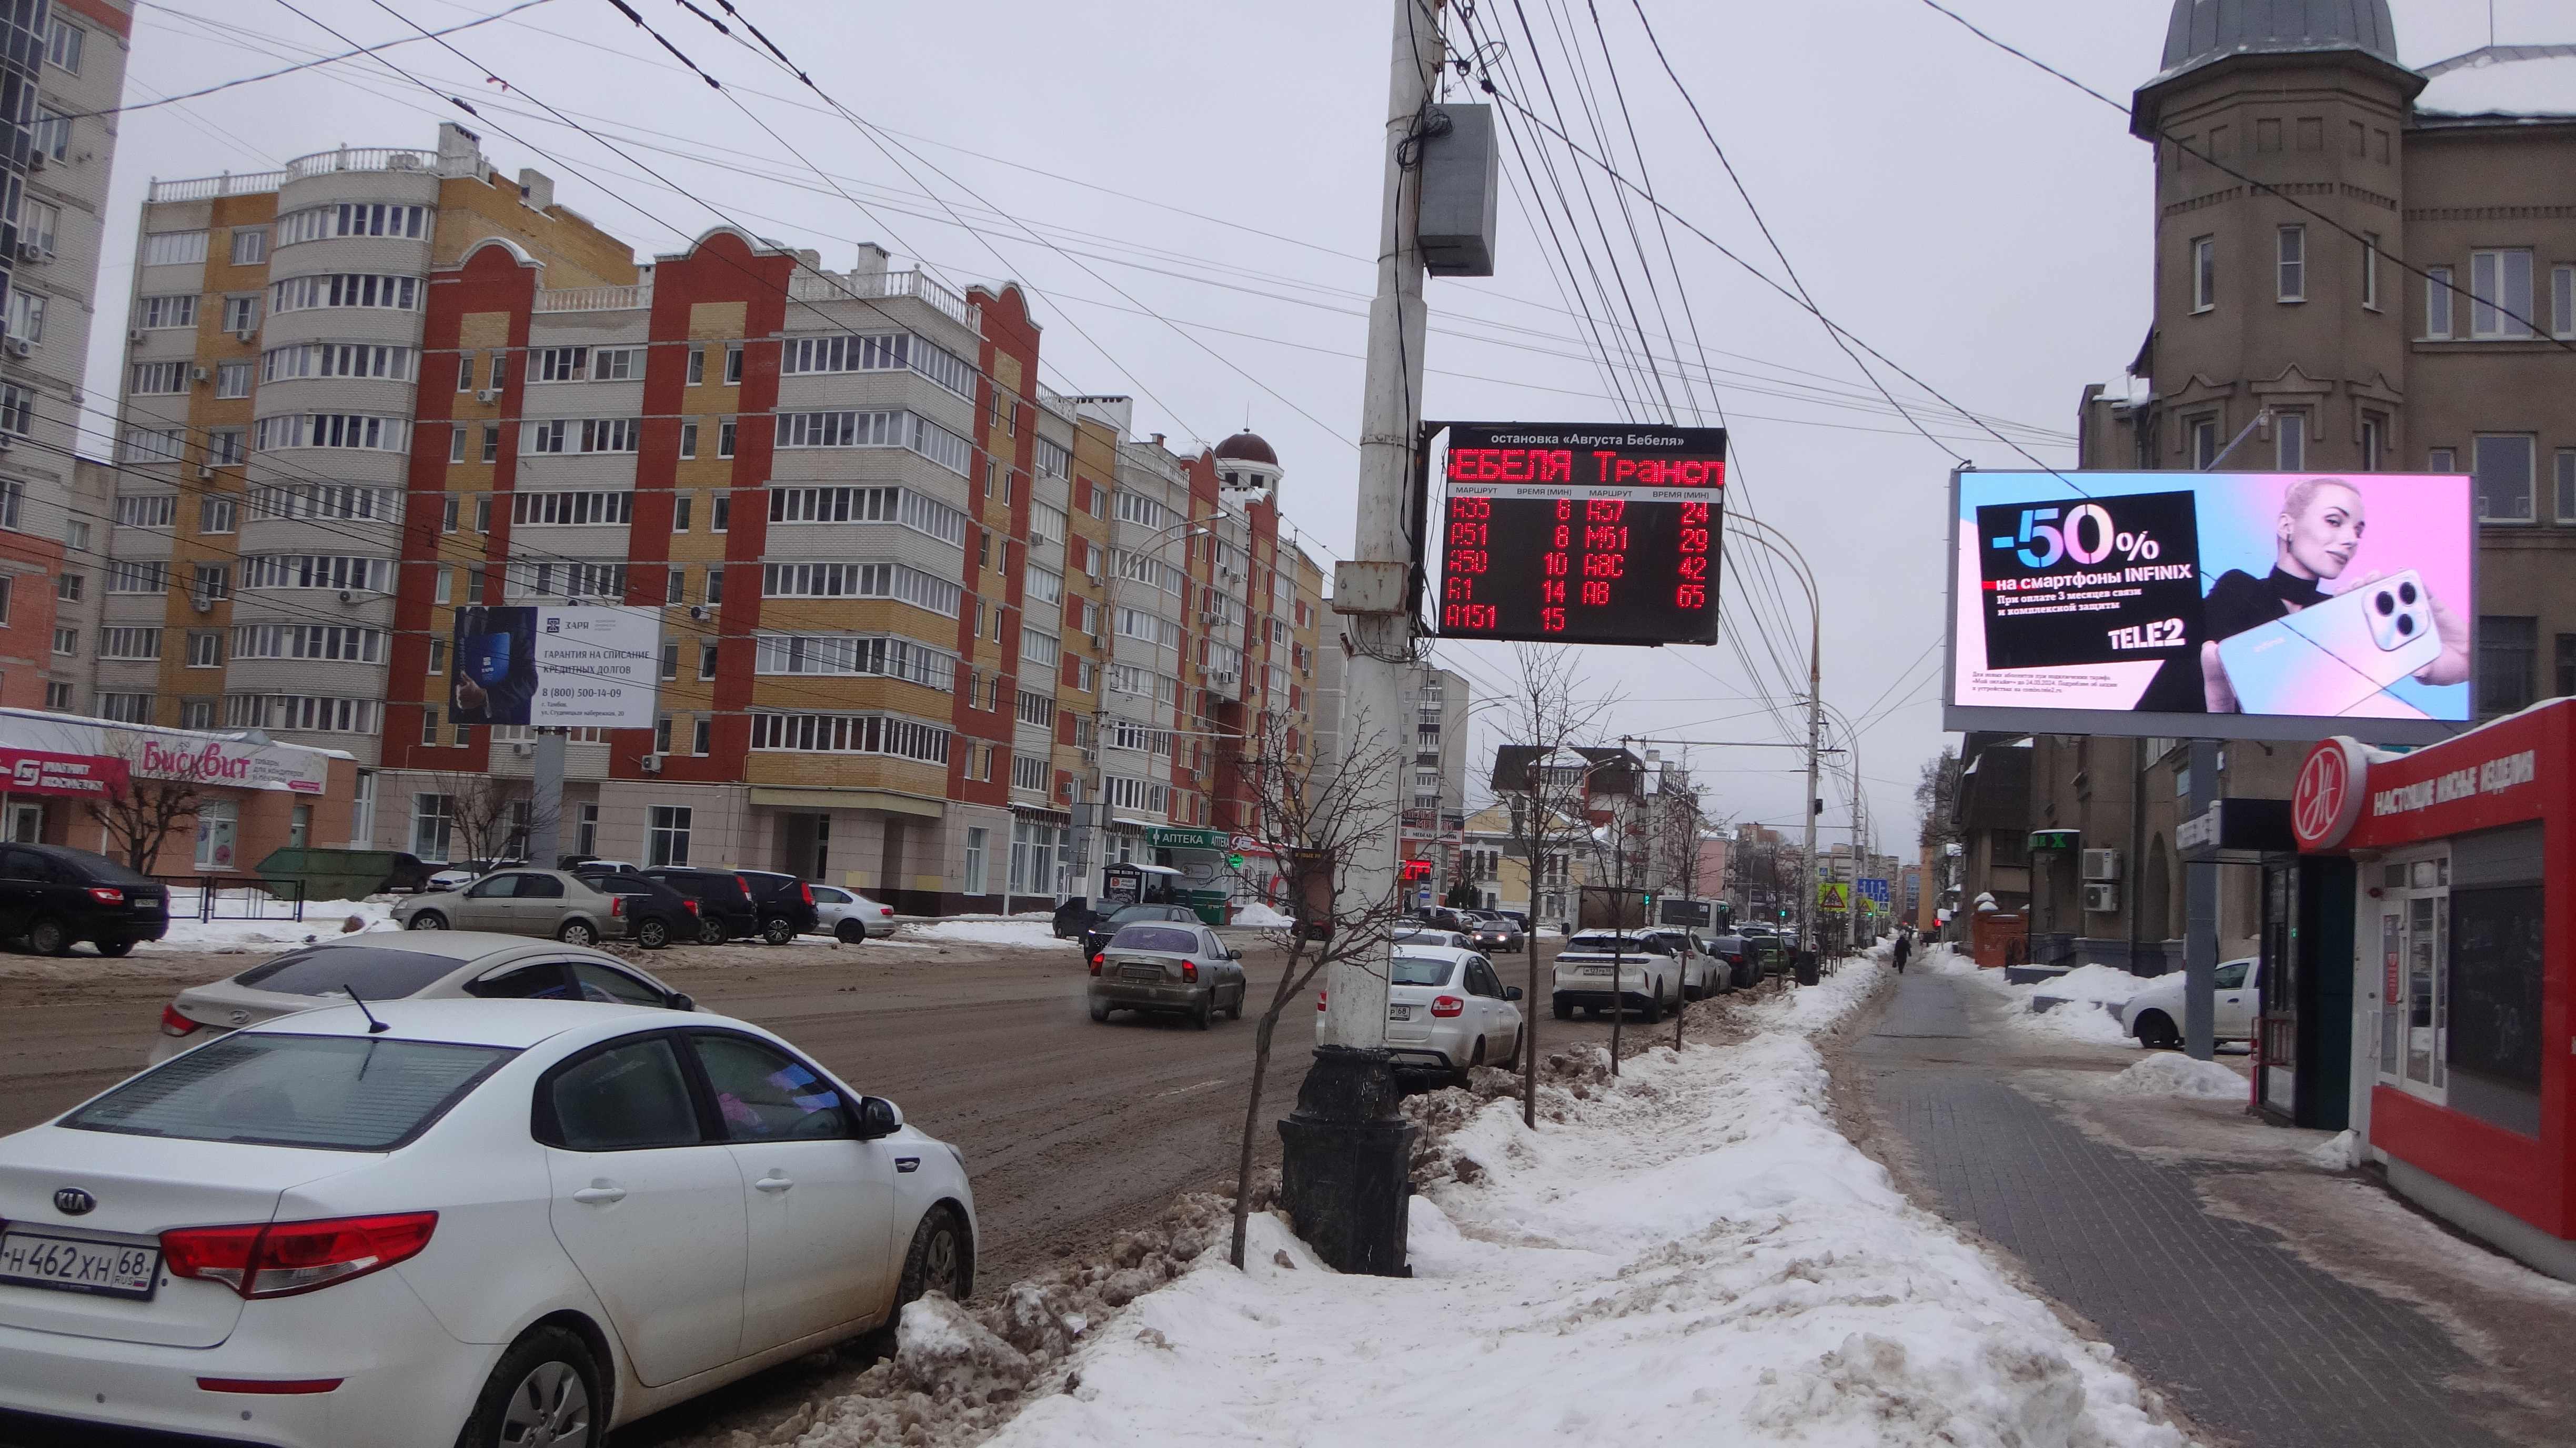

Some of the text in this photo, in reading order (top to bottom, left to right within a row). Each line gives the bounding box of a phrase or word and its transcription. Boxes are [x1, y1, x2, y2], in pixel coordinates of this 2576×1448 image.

[1491, 433, 1685, 446] остановка «Августа Бебеля»
[1557, 497, 1571, 520] 6
[1682, 500, 1709, 524] 24
[1556, 525, 1569, 548] 8
[1681, 528, 1708, 552] 29
[1544, 551, 1568, 576] 10
[1678, 556, 1707, 580] 42
[1996, 563, 2193, 591] на смартфоны INFINIX
[1542, 579, 1567, 604] 14
[1676, 584, 1706, 608] 65
[1996, 588, 2142, 606] При оплате 3 месяцев связи
[2007, 602, 2077, 616] комплексной
[2078, 601, 2120, 611] защиты
[565, 621, 589, 630] ЗАРЯ
[1542, 607, 1566, 631] 15
[2108, 618, 2186, 650] TELE2
[544, 650, 587, 659] ГАРАНТИЯ
[603, 650, 649, 659] СПИСАНИЕ
[543, 665, 631, 676] КРЕДИТНЫХ ДОЛГОВ
[542, 687, 622, 699] 8 (800) 500-14-09
[143, 741, 250, 780] Бисквит
[1415, 819, 1454, 831] МЕБЛИ
[1162, 833, 1204, 844] АПТЕКА
[1211, 835, 1230, 849] АПТЕКА
[58, 1192, 86, 1210] KIA
[118, 1250, 146, 1276] 68
[114, 1275, 134, 1285] RUS
